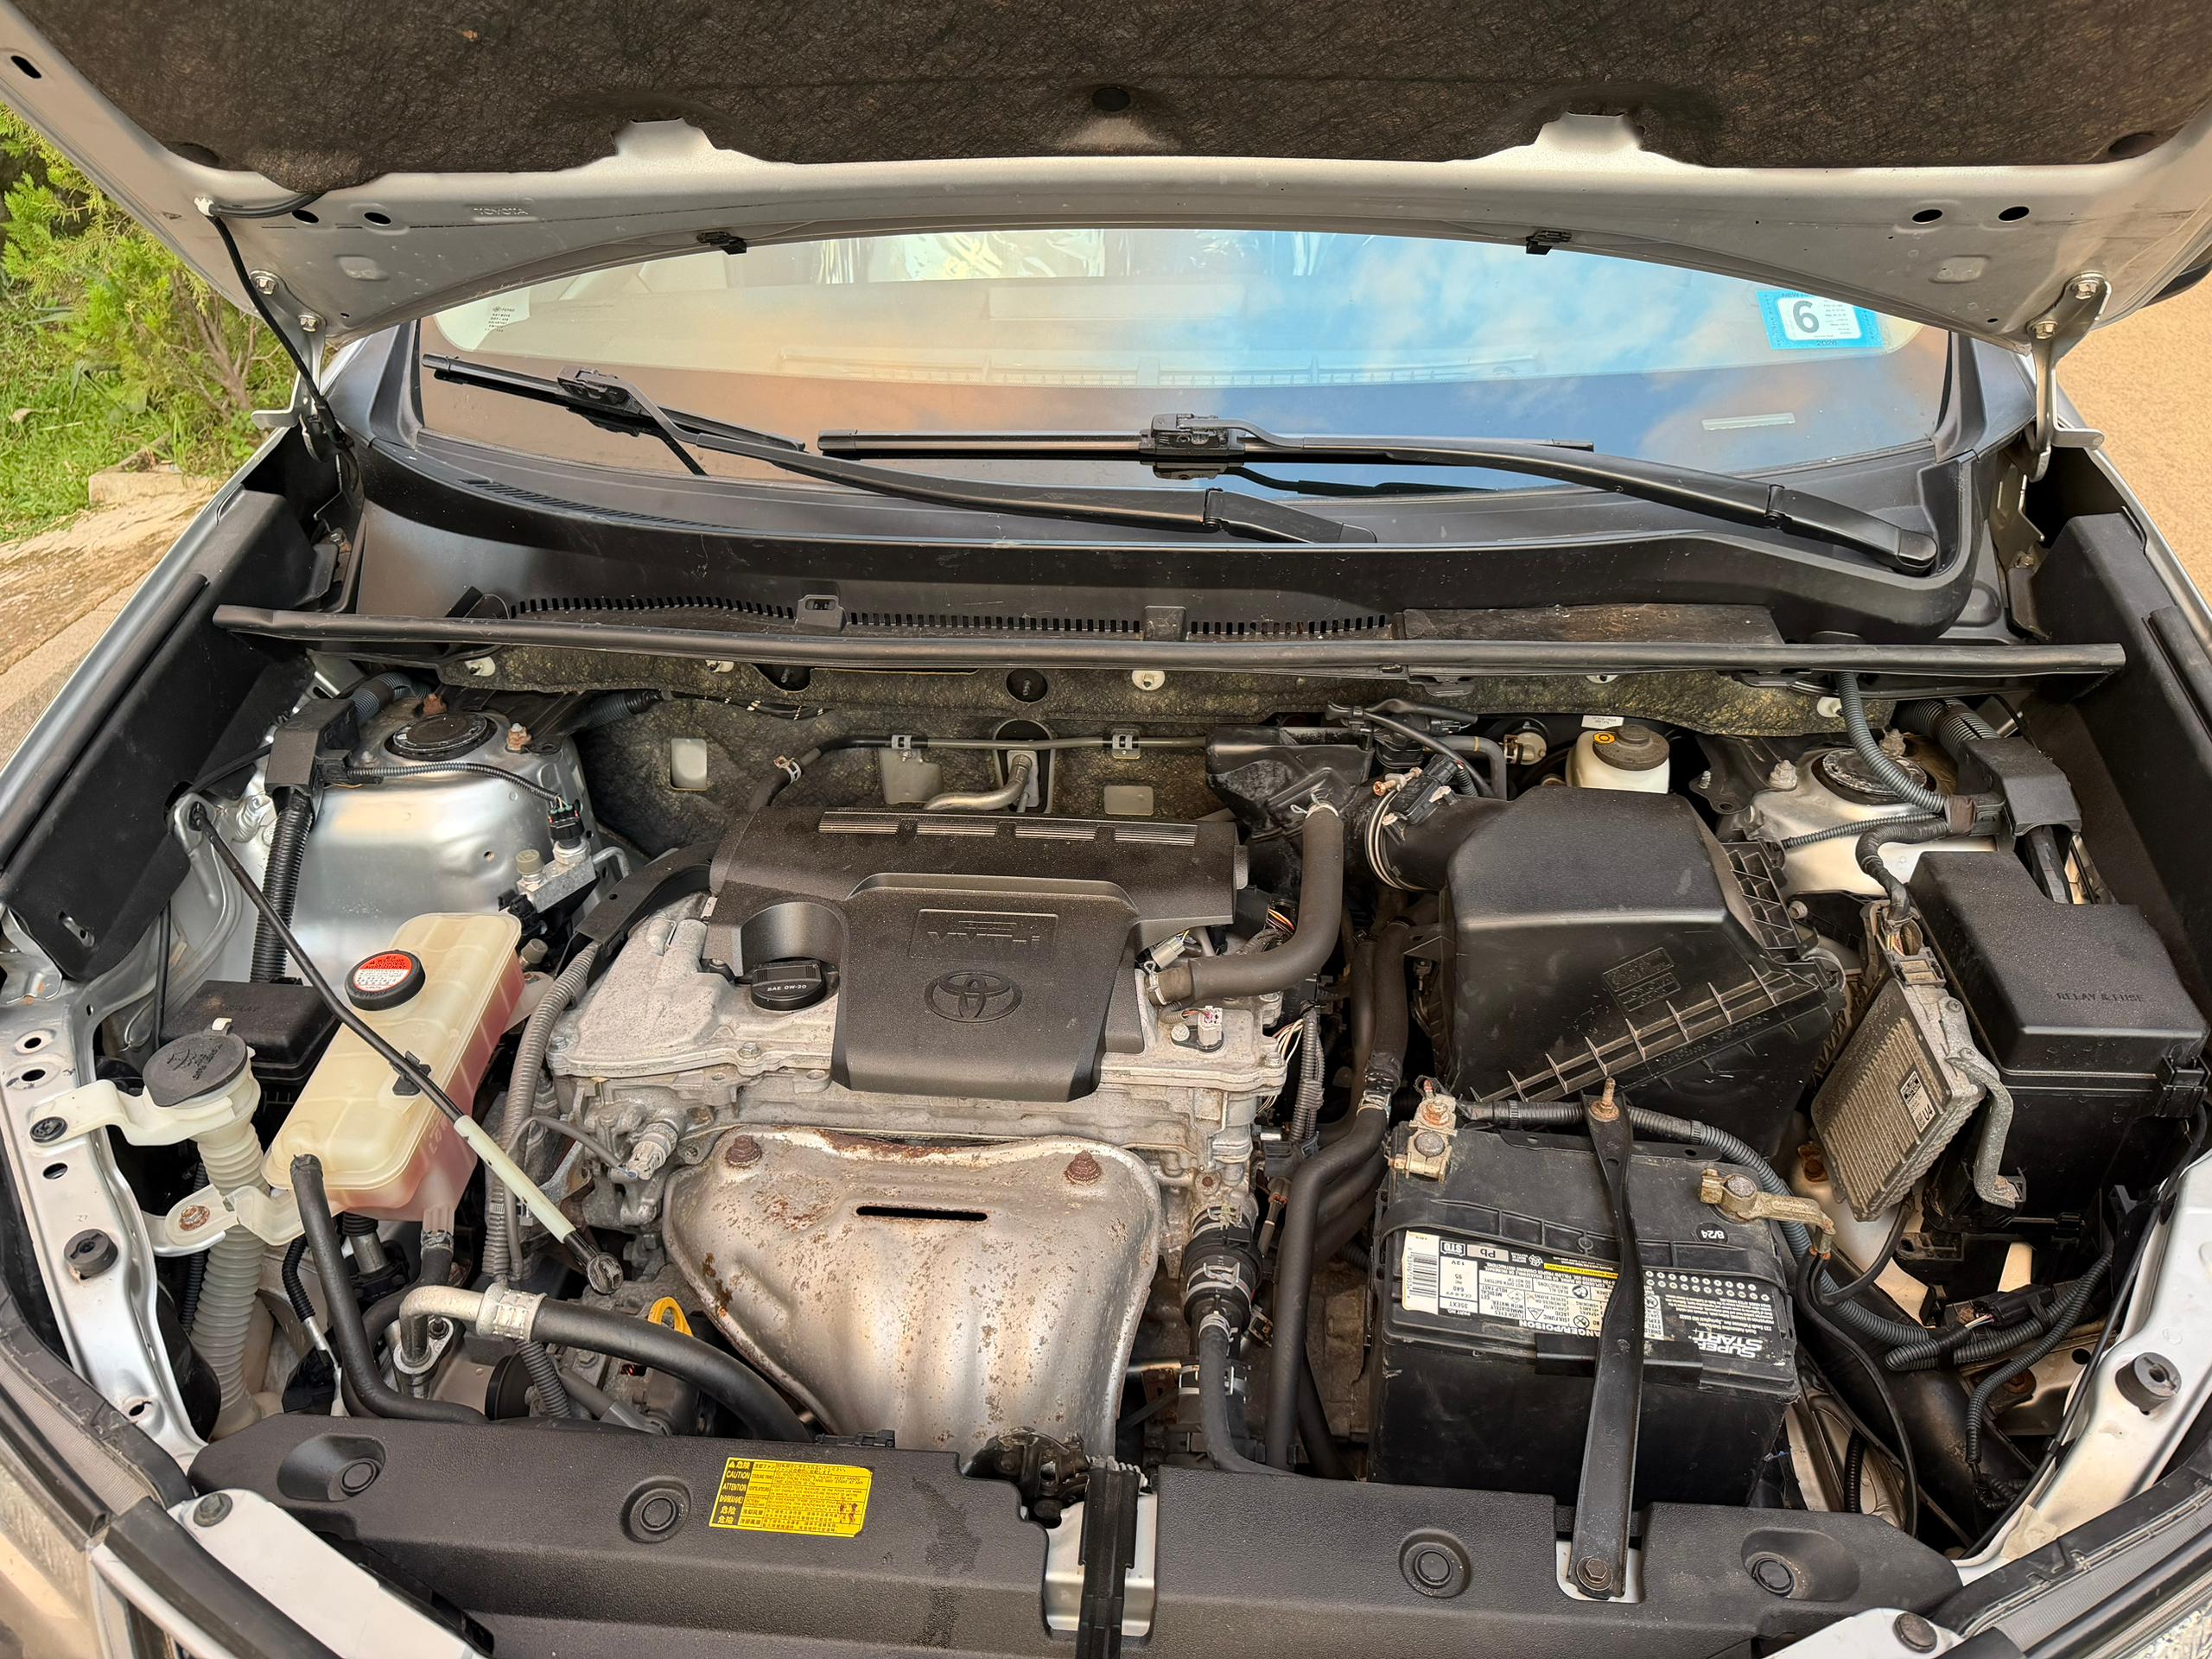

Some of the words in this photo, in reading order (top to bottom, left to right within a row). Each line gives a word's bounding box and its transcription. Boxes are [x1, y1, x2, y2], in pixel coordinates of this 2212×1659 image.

[1792, 300, 1820, 334] 6
[2056, 992, 2096, 1001] RELAY
[1922, 1103, 1933, 1121] U4
[1700, 1230, 1726, 1239] 8/24
[1479, 1249, 1497, 1259] Pb
[1481, 1289, 1503, 1298] MEDICAL
[1491, 1305, 1524, 1314] IMMEDIATELY
[1543, 1314, 1567, 1323] SULFURIC
[1519, 1319, 1601, 1338] ANGER/POISON
[1692, 1332, 1764, 1352] START
[726, 1470, 751, 1479] CAUTION
[722, 1482, 747, 1491] ATTENTION
